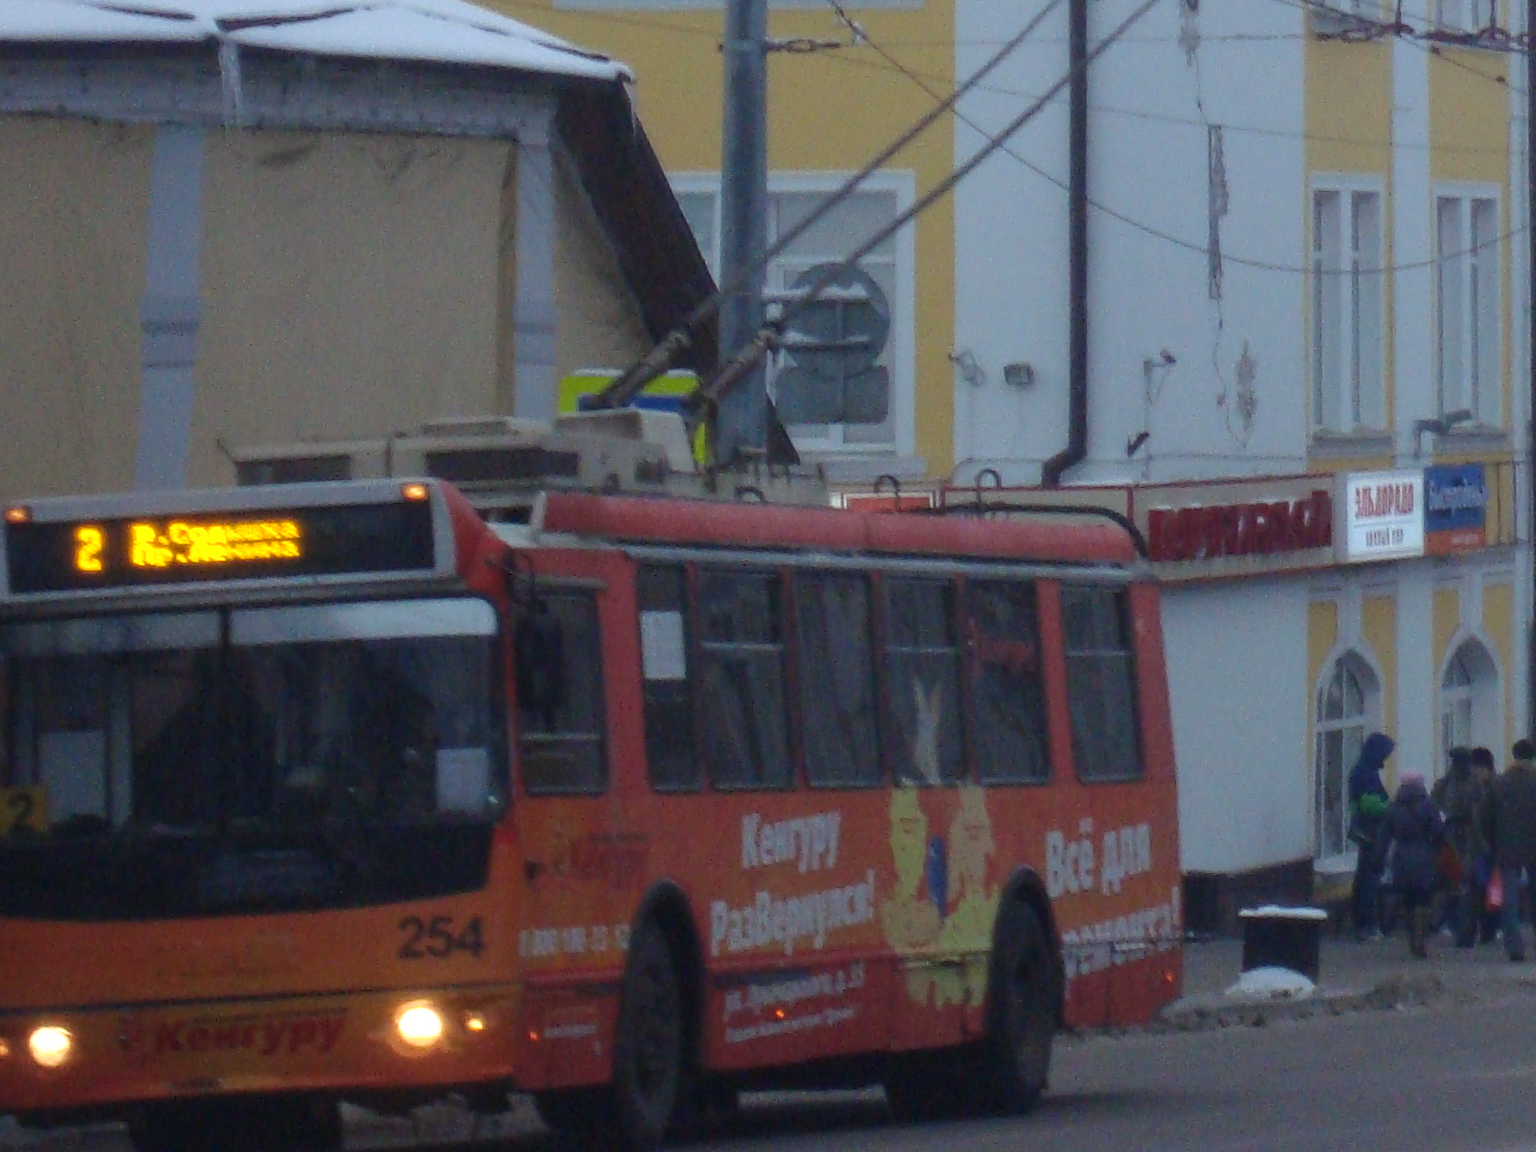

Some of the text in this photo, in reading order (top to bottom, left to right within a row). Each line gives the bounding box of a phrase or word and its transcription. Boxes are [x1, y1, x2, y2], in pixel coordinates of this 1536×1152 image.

[75, 526, 103, 572] 2
[741, 812, 842, 874] Кенгуру
[1046, 817, 1150, 898] Всё для
[399, 917, 484, 959] 254
[156, 1011, 347, 1056] Кенгуру
